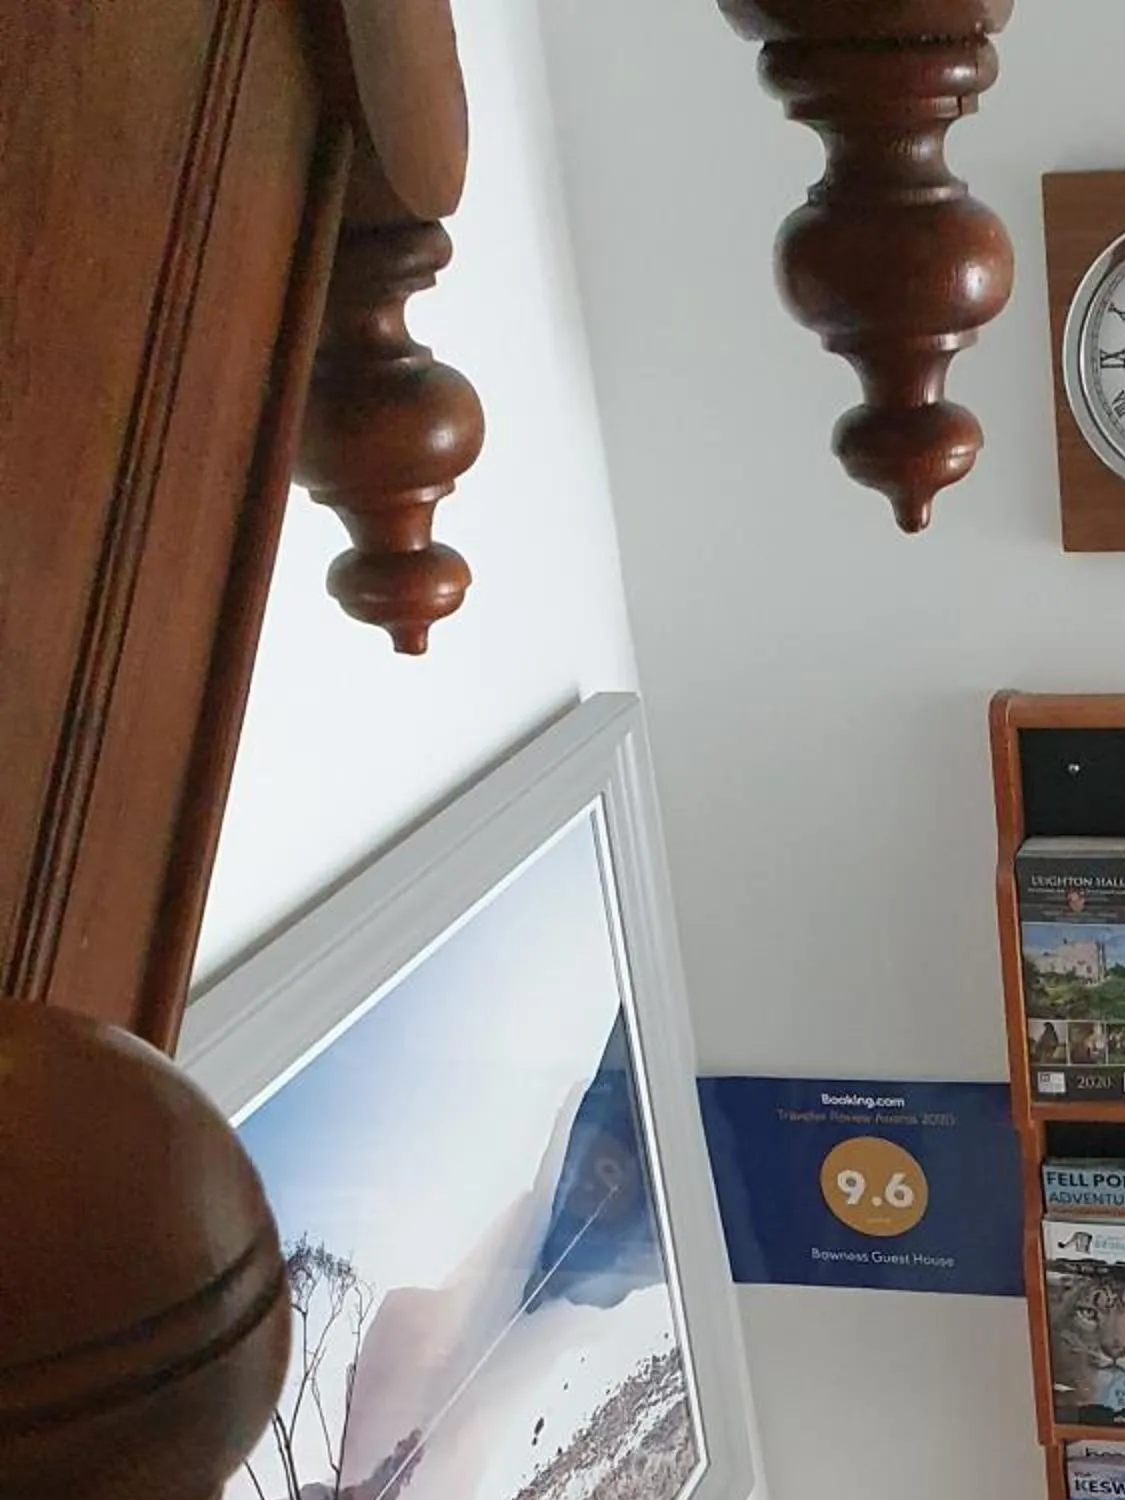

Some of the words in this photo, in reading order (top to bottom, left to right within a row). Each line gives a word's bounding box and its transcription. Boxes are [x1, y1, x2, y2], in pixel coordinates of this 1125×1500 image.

[1100, 349, 1125, 368] IX
[1077, 1076, 1111, 1089] 2020
[821, 1093, 905, 1108] Booking.com
[1047, 1171, 1088, 1187] FELL
[837, 1169, 915, 1208] 9.6
[812, 1248, 869, 1262] Bowness
[871, 1251, 909, 1265] Guest
[913, 1254, 955, 1268] House
